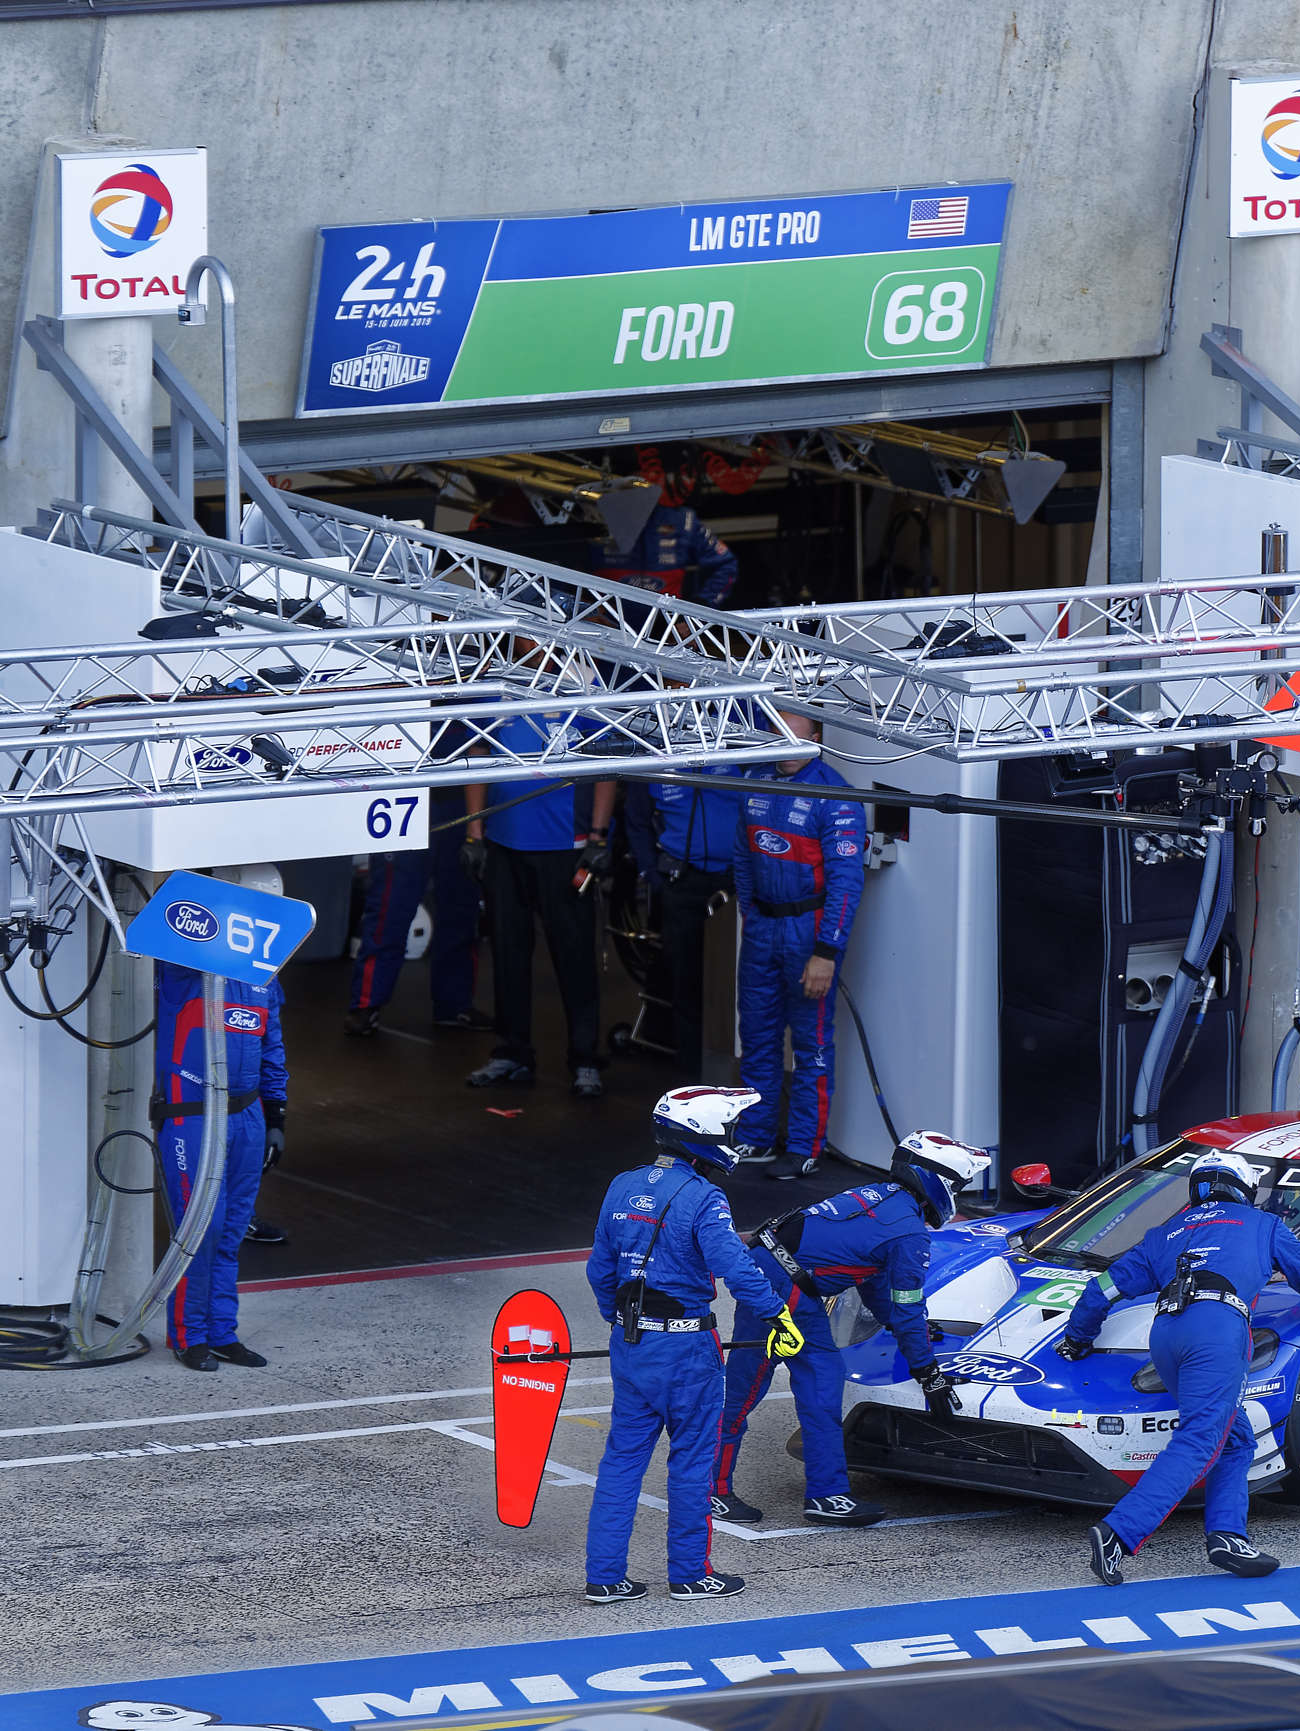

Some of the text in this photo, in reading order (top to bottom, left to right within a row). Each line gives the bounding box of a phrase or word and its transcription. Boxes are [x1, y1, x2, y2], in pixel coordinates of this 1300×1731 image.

[689, 210, 821, 252] LM GTE PRO
[71, 274, 187, 301] TOTAL
[341, 242, 446, 302] 24h
[335, 301, 437, 320] LE MANS
[613, 281, 968, 365] FORD 68
[332, 354, 427, 389] SUPERFINALE
[366, 796, 419, 838] 67
[174, 905, 280, 959] Ford 67
[228, 1009, 257, 1030] Ford
[174, 1137, 187, 1171] FORD
[1036, 1283, 1086, 1306] 6
[502, 1374, 555, 1393] ENGINE ON
[939, 1354, 1022, 1381] Ford
